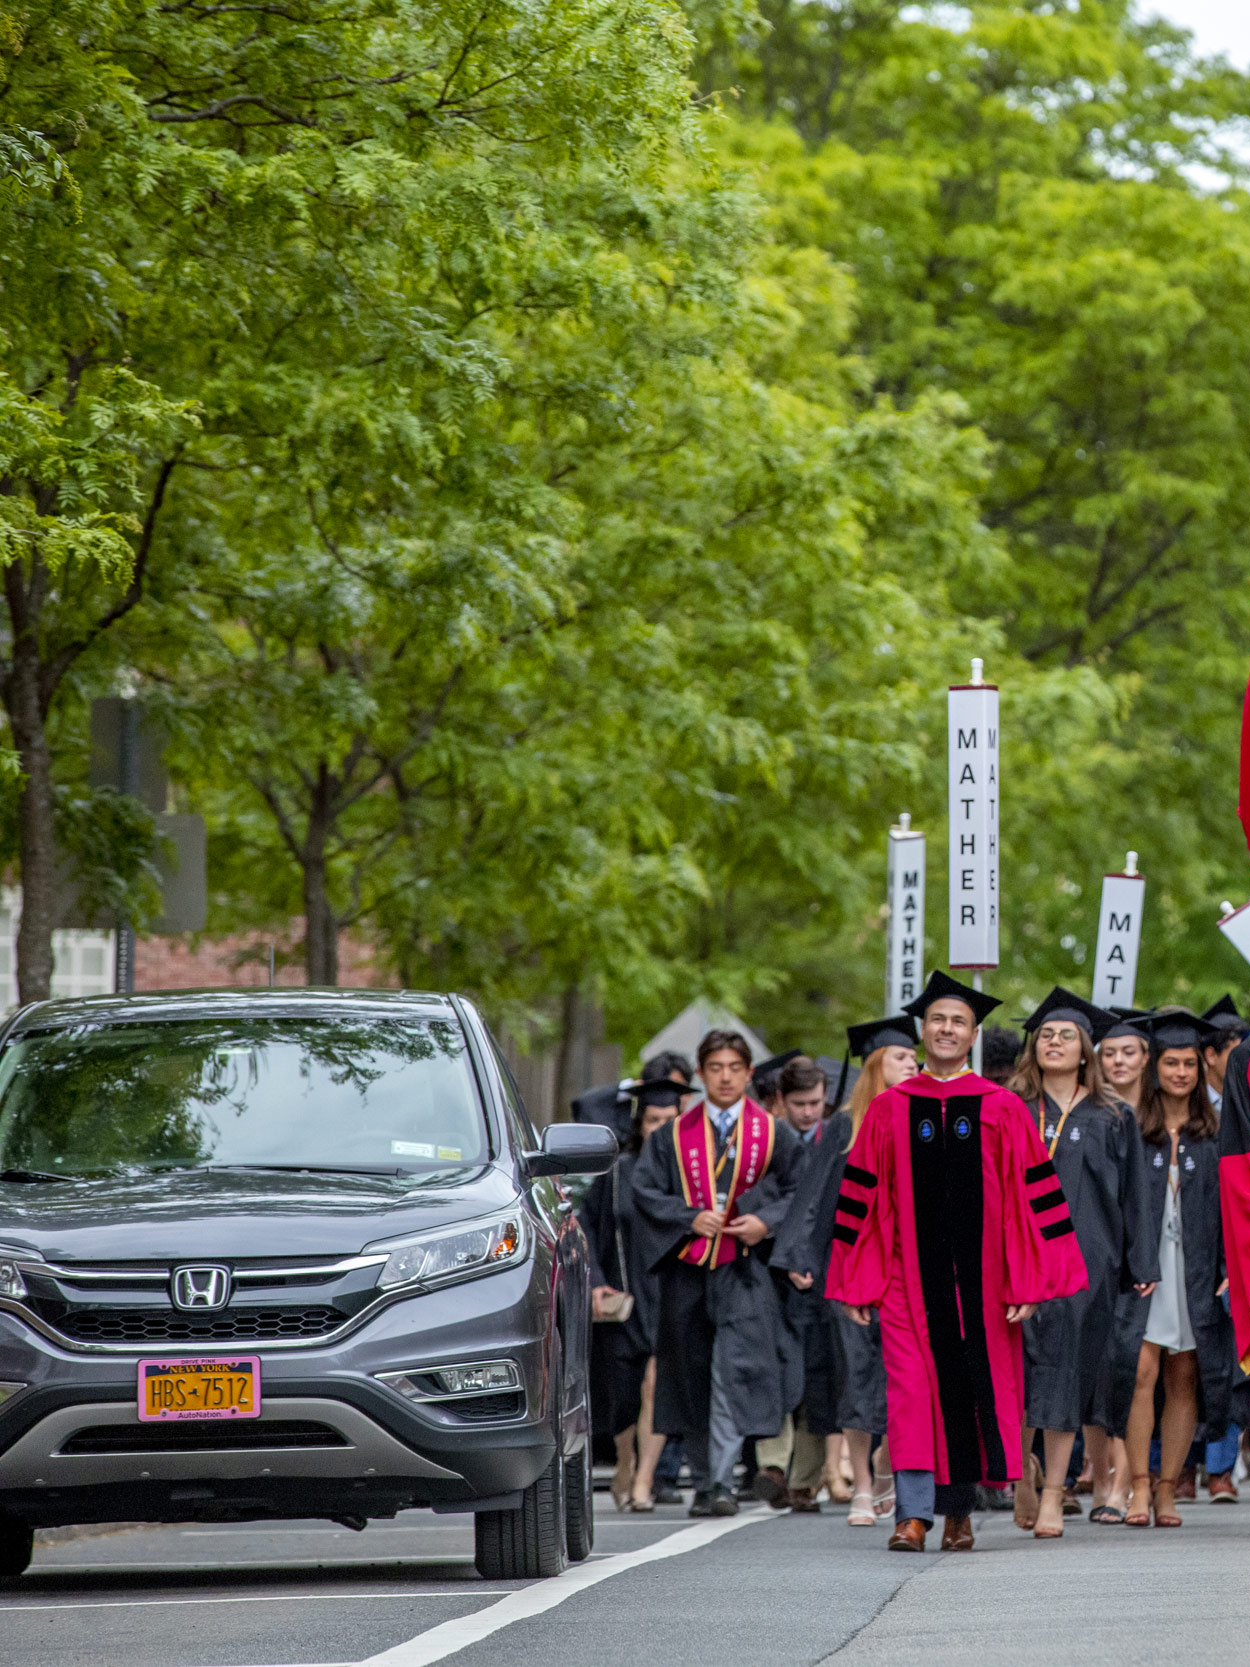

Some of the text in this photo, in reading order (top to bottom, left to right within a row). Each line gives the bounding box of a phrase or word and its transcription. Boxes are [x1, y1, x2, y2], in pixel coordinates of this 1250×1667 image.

[957, 728, 977, 926] MATHER
[901, 871, 918, 1000] MATHER
[169, 1364, 231, 1374] NEW YORK
